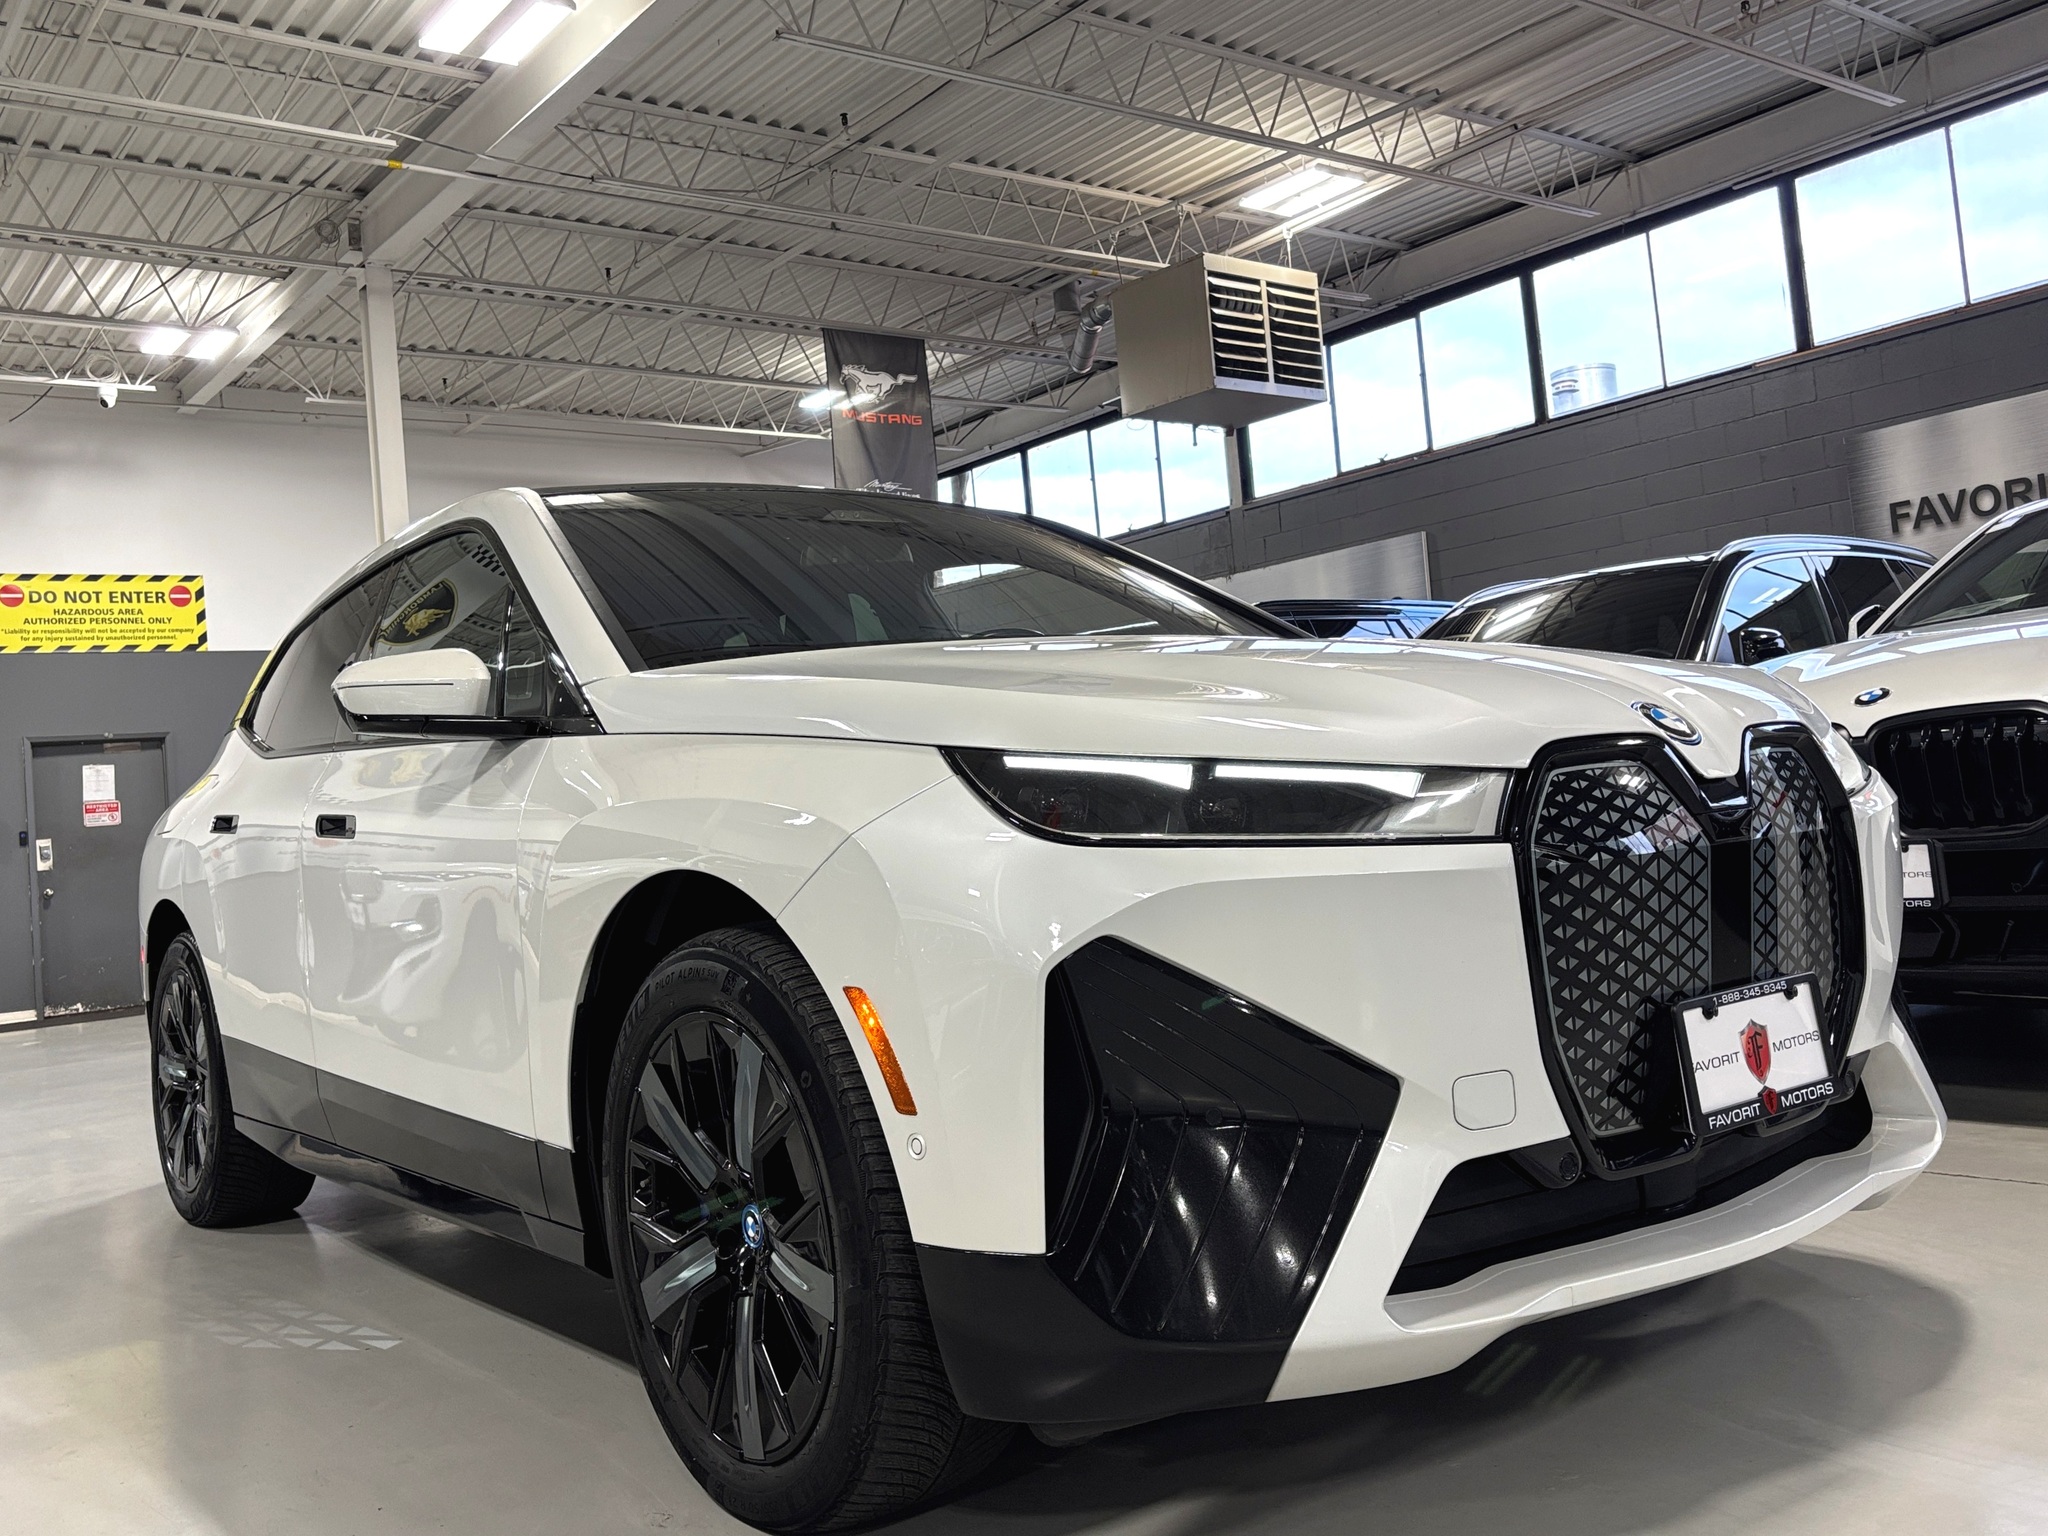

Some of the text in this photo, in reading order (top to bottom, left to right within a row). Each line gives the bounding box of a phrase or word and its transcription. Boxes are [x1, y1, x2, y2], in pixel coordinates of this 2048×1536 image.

[842, 409, 923, 426] MUSTANG
[1889, 473, 2048, 534] FAVORI
[28, 590, 166, 604] DO NOT ENTER
[23, 617, 87, 625] AUTHORIZED
[89, 617, 146, 625] PERSONNEL
[53, 608, 144, 616] HAZARDOUS AREA
[1902, 900, 1932, 908] ORS
[654, 971, 675, 992] PILOT
[677, 967, 701, 981] ALPIN
[706, 969, 720, 980] SUV
[1712, 980, 1788, 1006] 1-888-345-9345
[1772, 1030, 1821, 1053] MOTORS
[1708, 1103, 1761, 1130] FAVORIT
[1781, 1082, 1834, 1108] MOTORS
